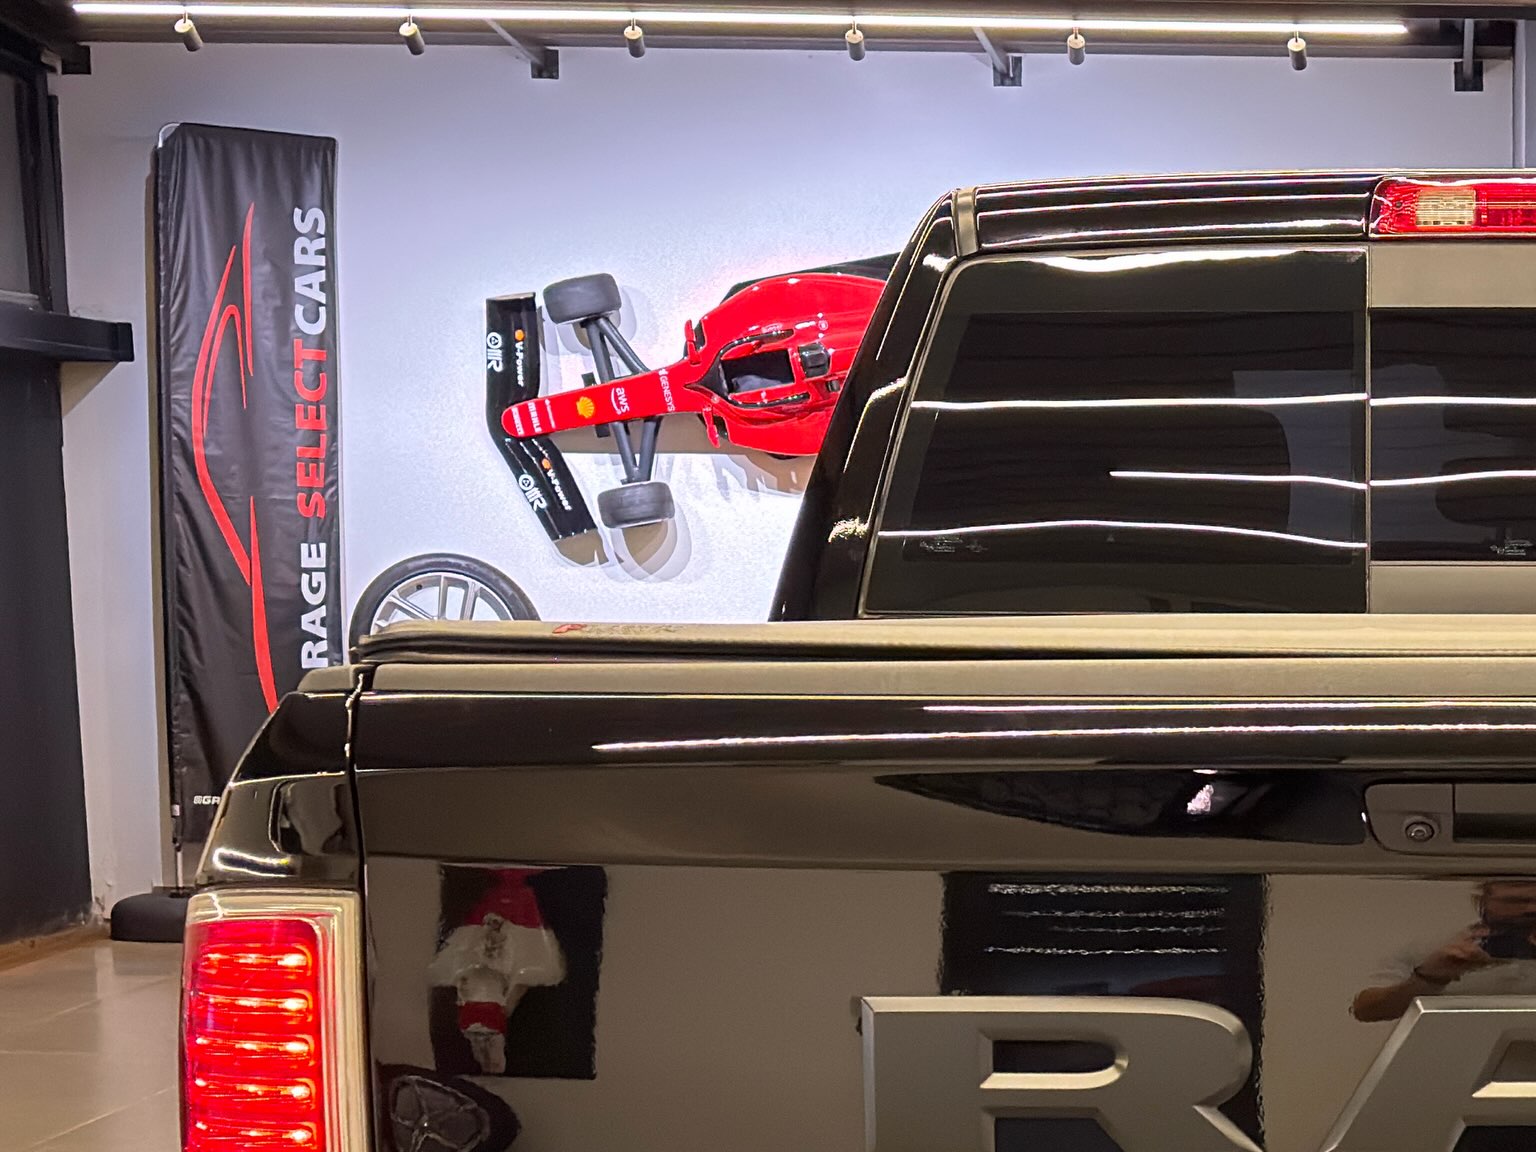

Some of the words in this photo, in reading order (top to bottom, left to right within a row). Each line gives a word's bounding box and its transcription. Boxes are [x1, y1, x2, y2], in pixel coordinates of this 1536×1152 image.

[293, 206, 327, 335] CARS
[514, 342, 525, 387] V-Power
[614, 387, 630, 413] aws
[659, 375, 676, 412] GENESYS
[294, 338, 328, 518] SELECT
[546, 468, 573, 511] V-Power
